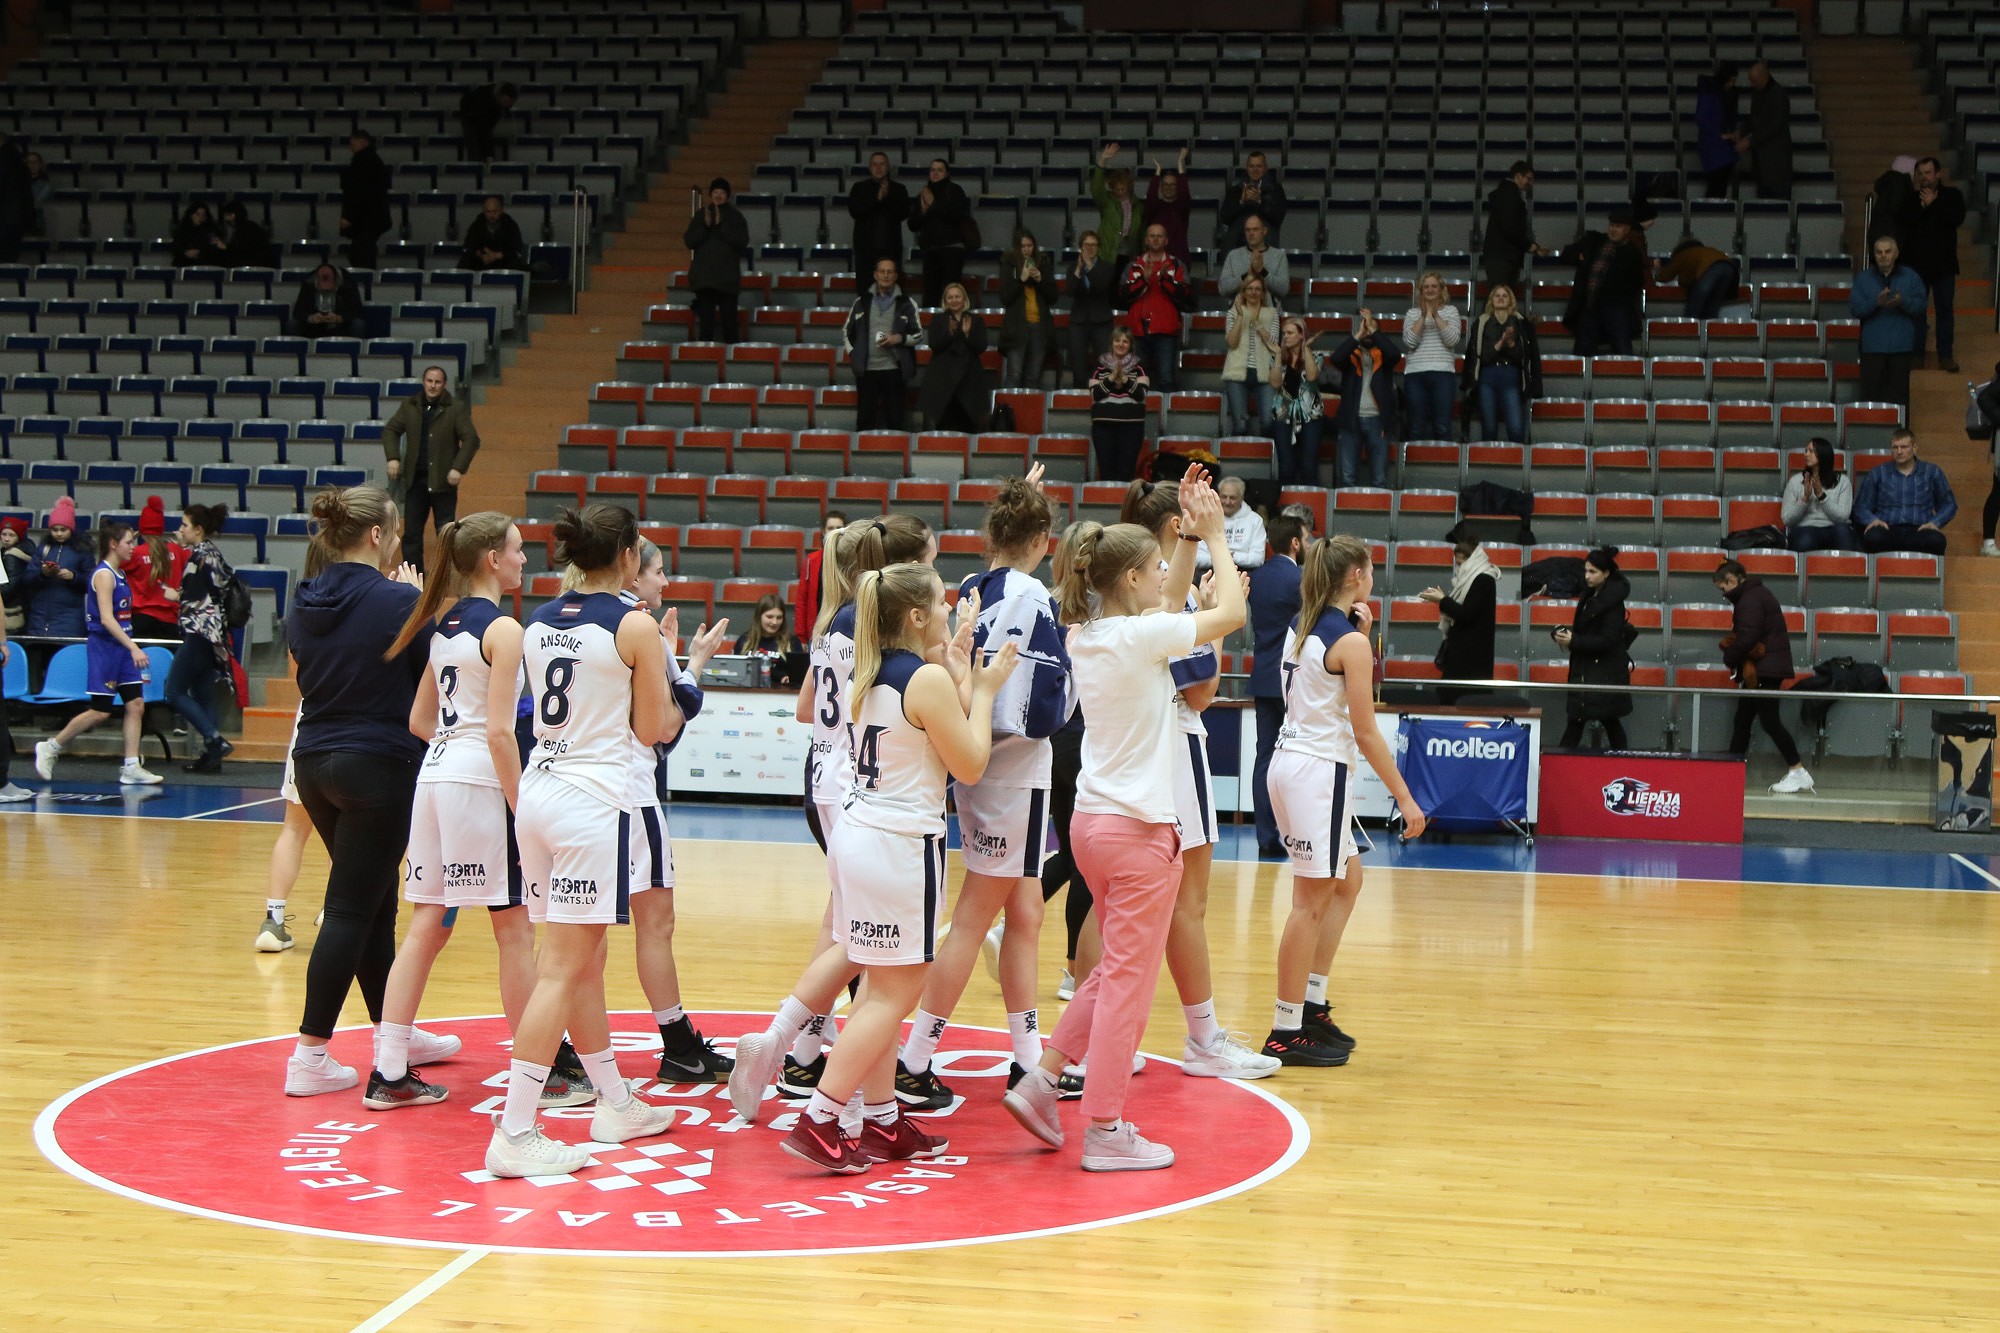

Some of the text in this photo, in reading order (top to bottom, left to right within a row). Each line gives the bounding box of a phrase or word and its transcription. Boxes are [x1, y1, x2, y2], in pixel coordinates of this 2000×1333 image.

[540, 633, 583, 654] ANSONE
[540, 657, 583, 730] 8
[1426, 737, 1516, 761] molten
[1645, 803, 1681, 818] LSSS
[551, 877, 598, 894] SPORTA
[551, 895, 598, 906] PUNKTS.LV
[850, 919, 901, 938] SPORTA
[850, 935, 901, 950] PUNKTS.LV
[279, 1120, 969, 1228] BASKETBALL LEAGUE
